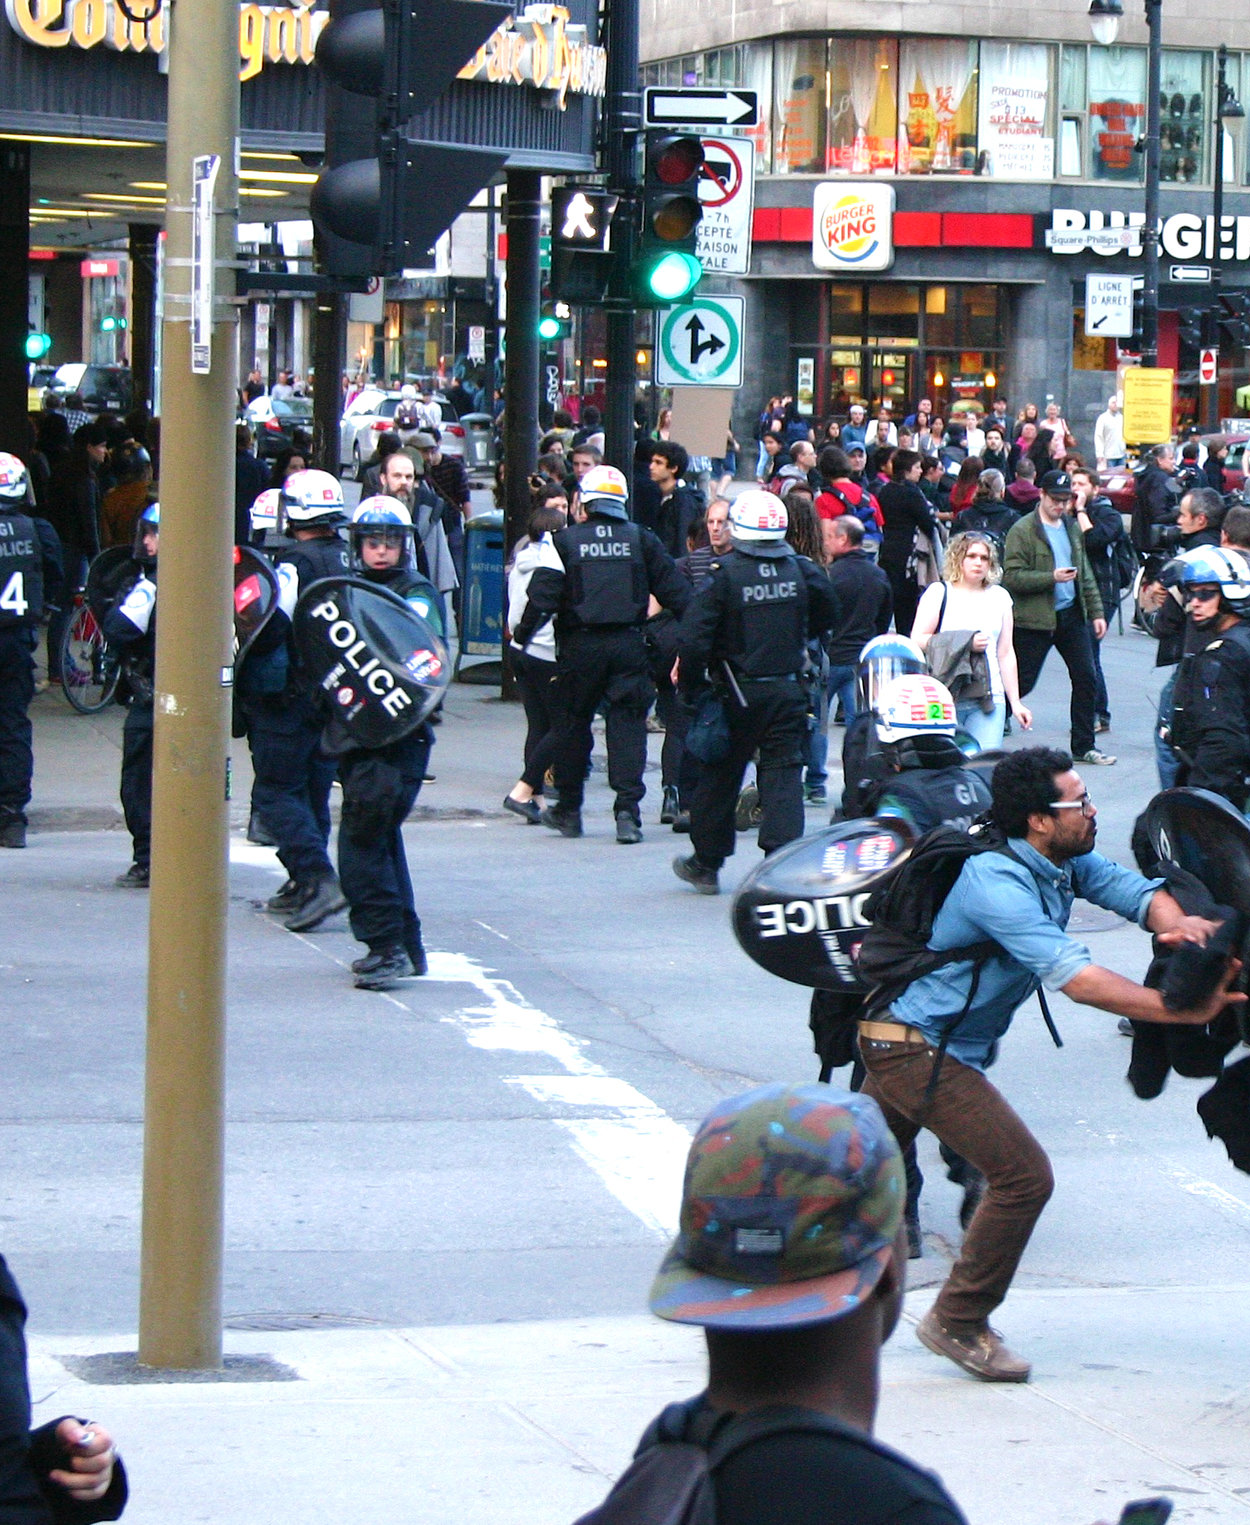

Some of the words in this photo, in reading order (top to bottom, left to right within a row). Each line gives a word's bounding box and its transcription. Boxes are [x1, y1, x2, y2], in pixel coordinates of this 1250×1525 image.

[825, 204, 874, 229] BURGER
[695, 224, 732, 239] CEPTÉ
[827, 216, 876, 248] KING
[696, 240, 738, 254] RAISON
[1050, 234, 1084, 246] Square
[1098, 282, 1122, 292] LIGNE
[595, 525, 613, 537] GI
[0, 540, 34, 557] LICE
[580, 542, 631, 557] POLICE
[759, 563, 778, 578] GI
[742, 581, 798, 602] POLICE
[311, 600, 413, 718] POLICE
[931, 704, 941, 719] 2
[954, 781, 979, 806] GI
[756, 892, 874, 939] OLICE
